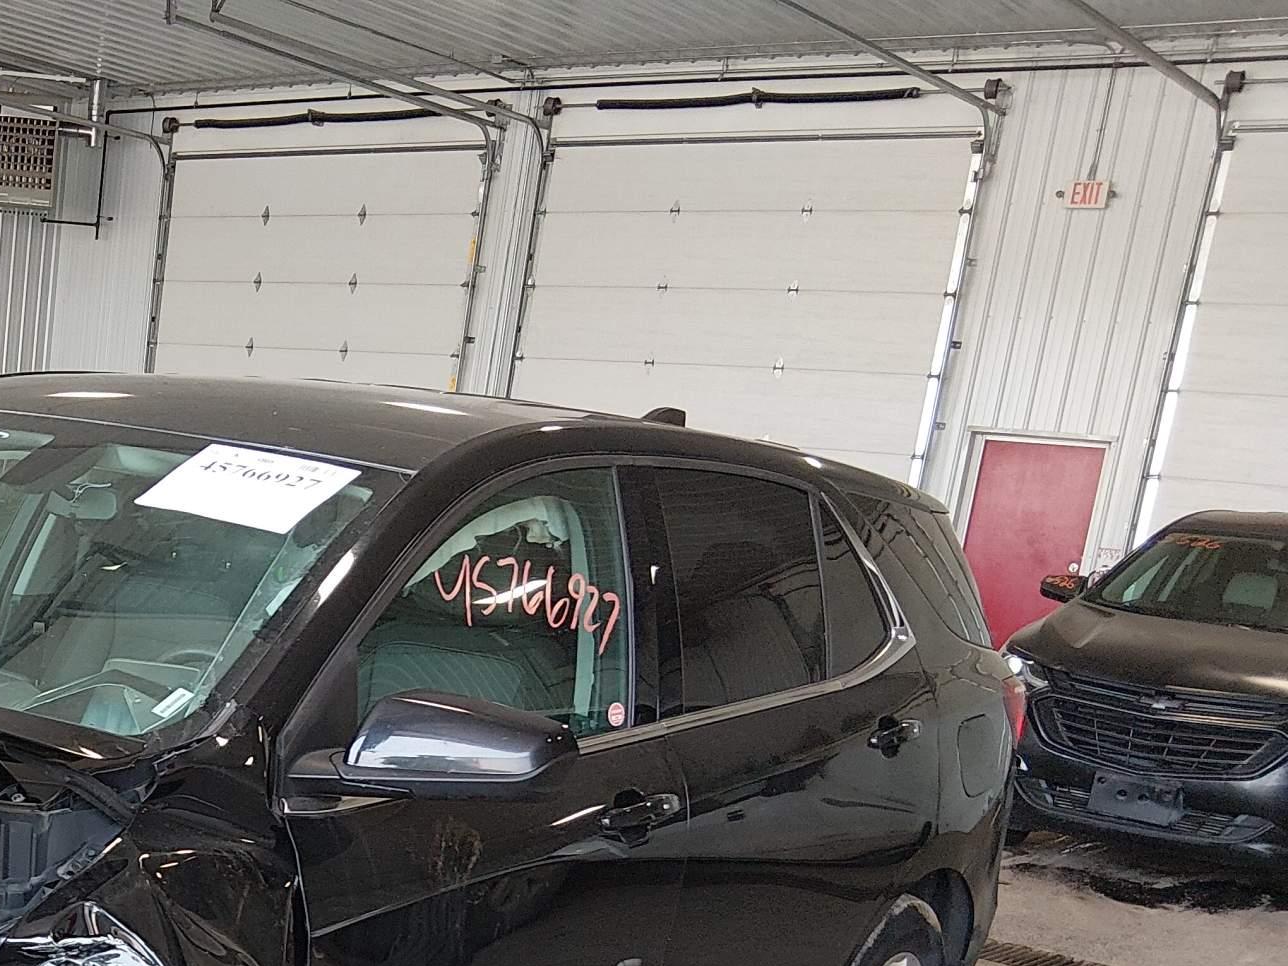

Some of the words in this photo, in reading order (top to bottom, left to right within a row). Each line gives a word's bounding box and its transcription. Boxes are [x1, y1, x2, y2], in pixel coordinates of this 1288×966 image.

[1070, 182, 1103, 205] EXIT
[200, 460, 324, 490] 45766927
[434, 554, 620, 656] 45766927
